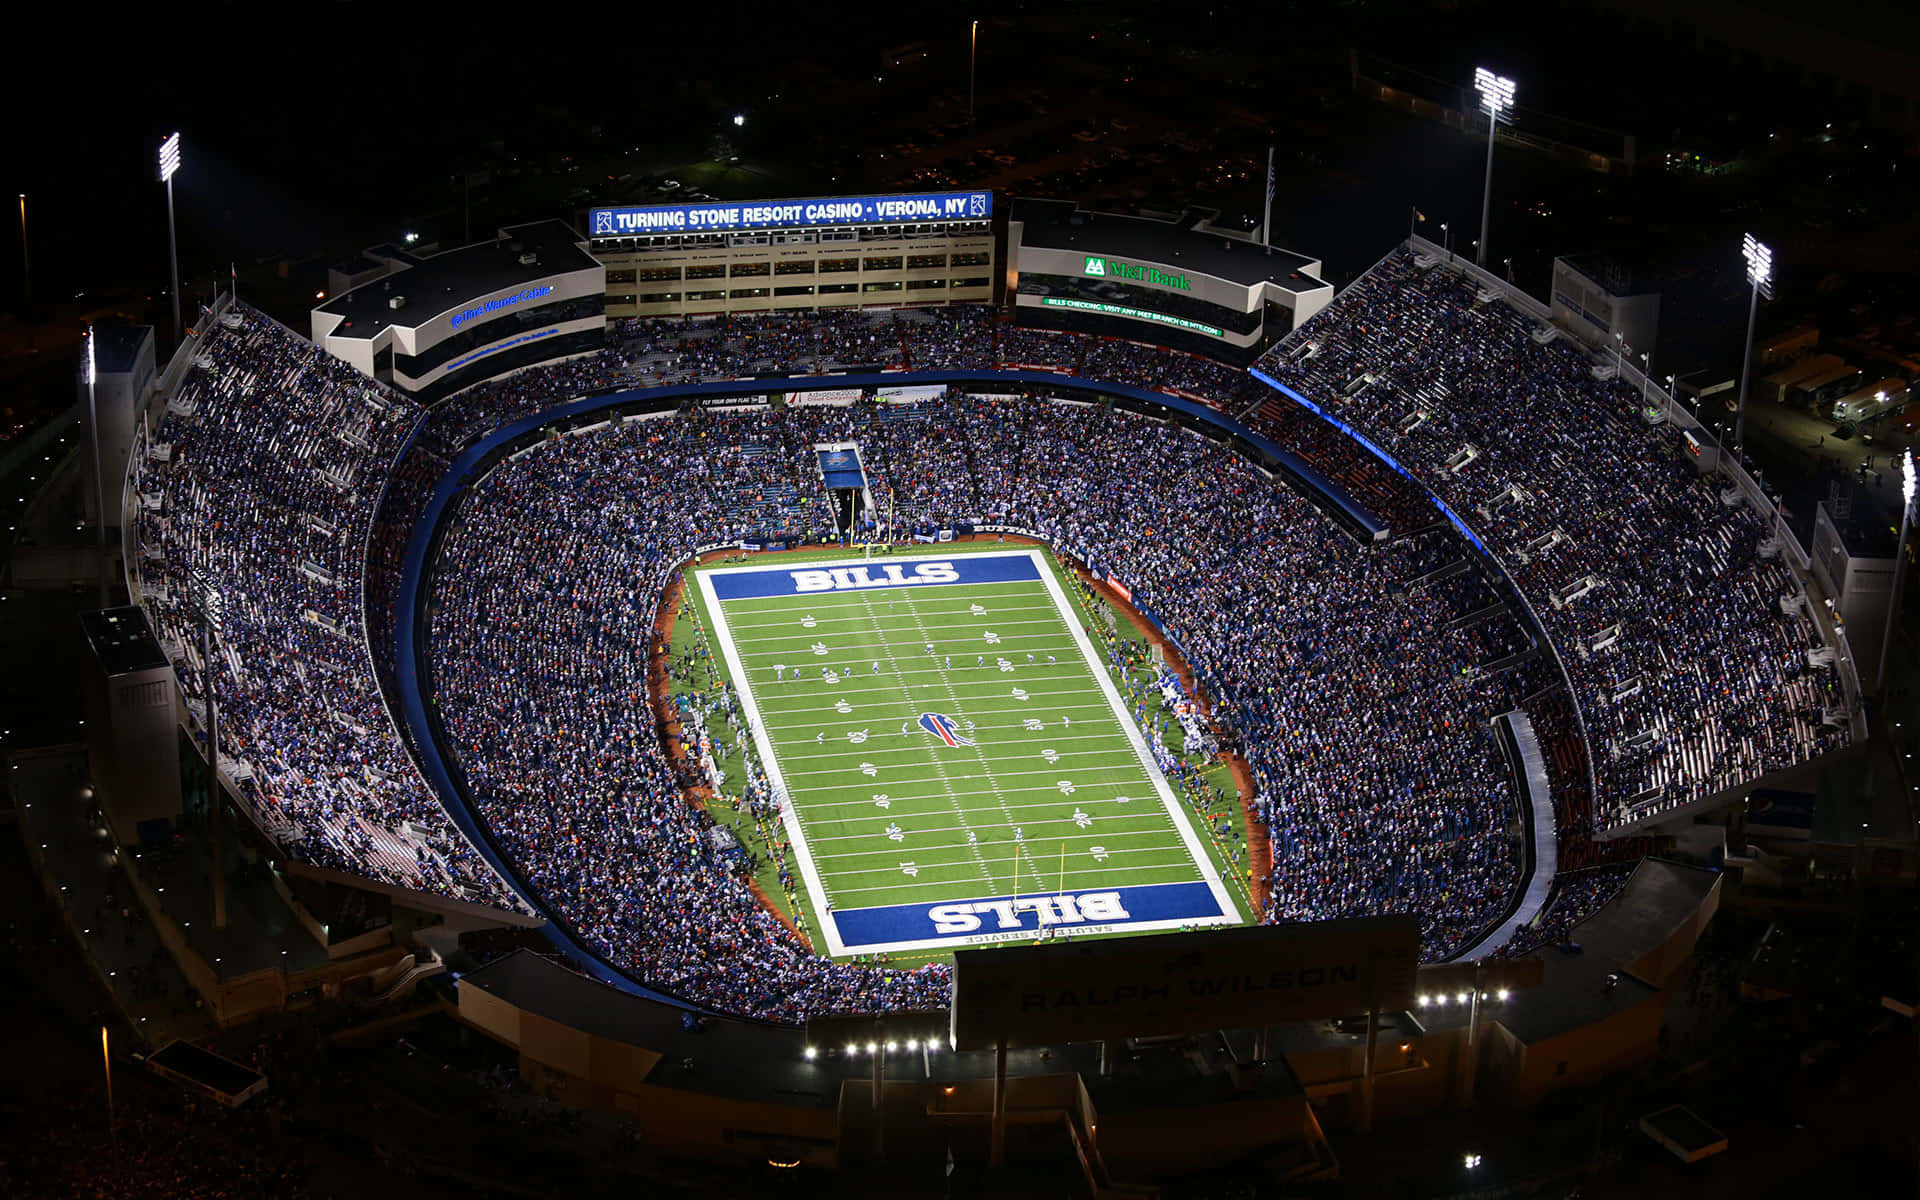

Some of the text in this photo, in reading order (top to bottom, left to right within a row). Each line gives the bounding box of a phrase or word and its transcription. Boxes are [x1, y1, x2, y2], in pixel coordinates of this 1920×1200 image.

[617, 198, 967, 229] TURNING STONE RESORT CASINO VERONA, NY
[1110, 262, 1192, 292] M&T Bank
[462, 286, 552, 321] Time Warner Cable
[1048, 298, 1066, 306] BILLS
[1104, 304, 1120, 313] VISIT
[1120, 306, 1136, 316] ANY
[973, 524, 1050, 541] BUFFALO
[790, 562, 960, 592] BILLS
[928, 892, 1130, 934] BILLS
[966, 931, 1030, 944] SERVICE
[1055, 925, 1112, 938] SALUTE
[1021, 964, 1358, 1014] RALPH WILSON
